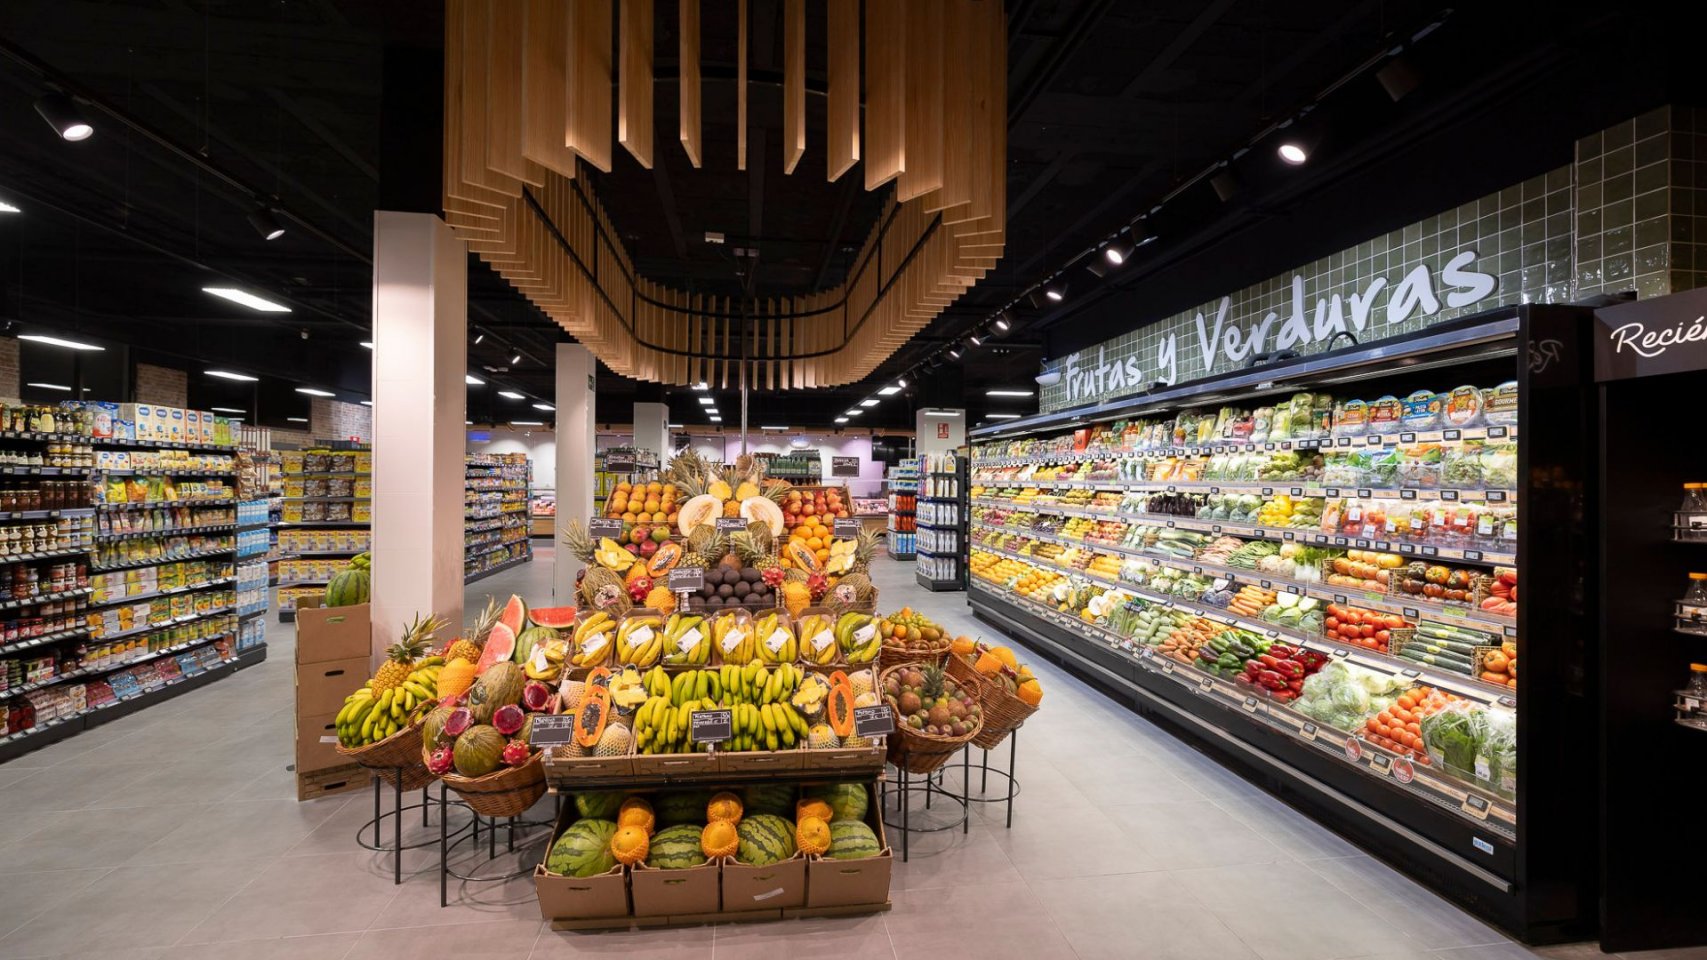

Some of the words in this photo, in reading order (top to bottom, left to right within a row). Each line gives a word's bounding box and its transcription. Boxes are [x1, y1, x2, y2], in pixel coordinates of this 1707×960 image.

[1065, 346, 1142, 401] Frutas
[1158, 332, 1178, 386] y
[1195, 250, 1498, 372] Verduras
[1610, 315, 1707, 358] Recié
